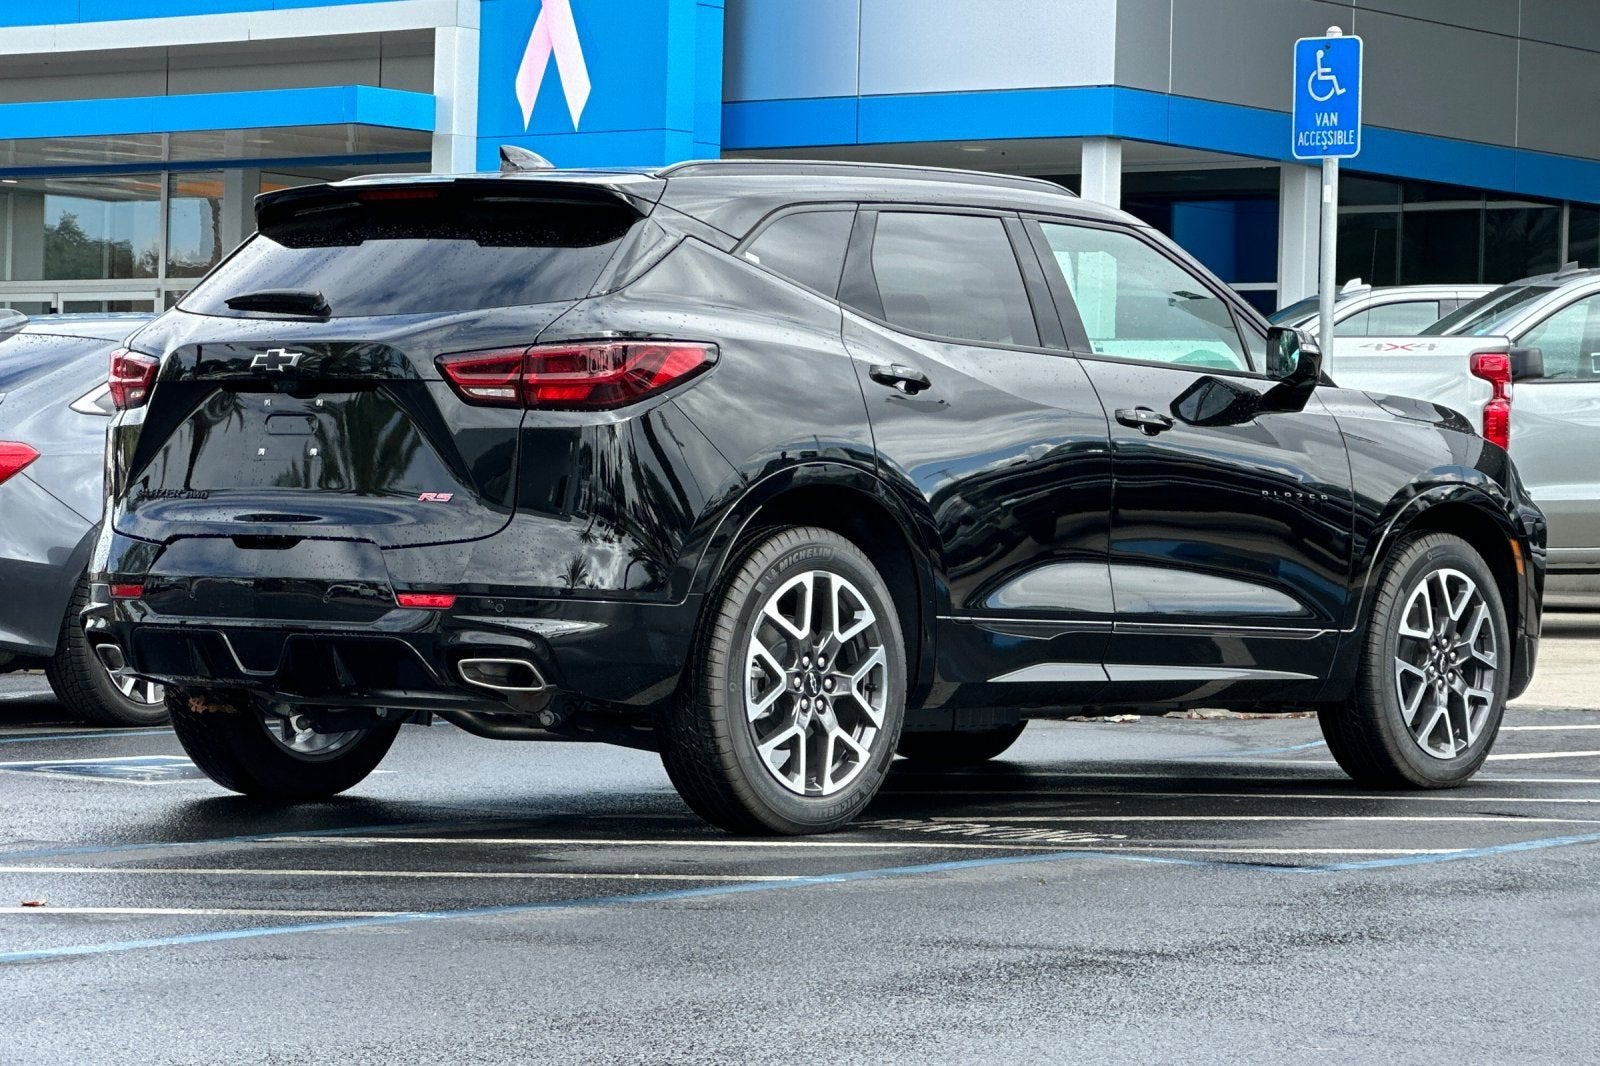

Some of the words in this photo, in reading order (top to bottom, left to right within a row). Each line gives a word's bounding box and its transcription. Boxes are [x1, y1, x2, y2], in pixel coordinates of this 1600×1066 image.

[1315, 112, 1338, 127] VAN
[1298, 130, 1355, 146] ACCESSIBLE
[418, 492, 453, 502] RS
[779, 547, 832, 572] MICHELIN
